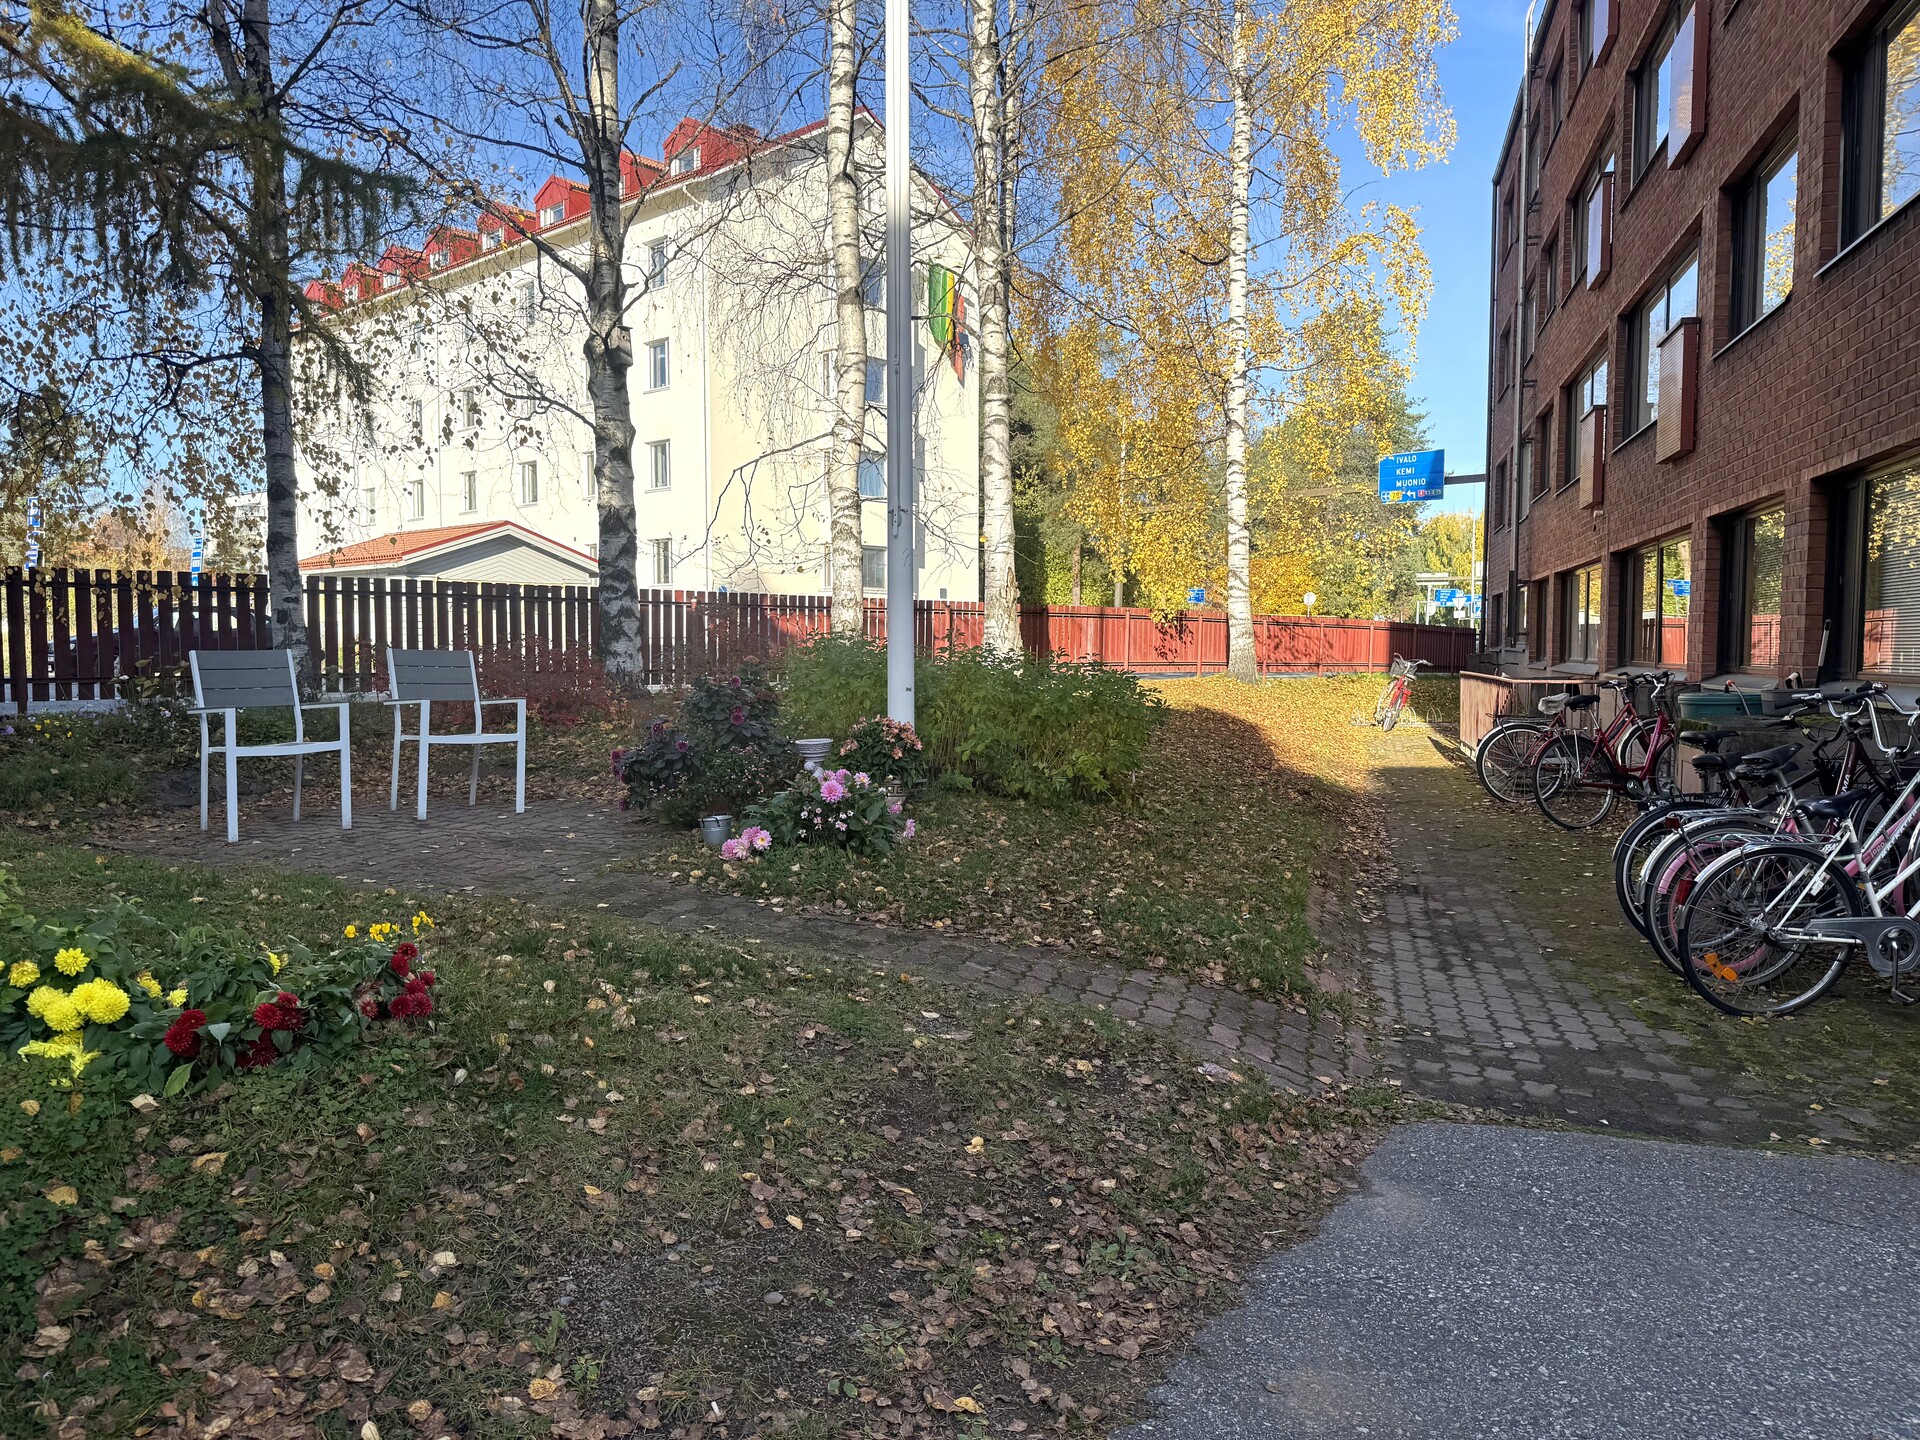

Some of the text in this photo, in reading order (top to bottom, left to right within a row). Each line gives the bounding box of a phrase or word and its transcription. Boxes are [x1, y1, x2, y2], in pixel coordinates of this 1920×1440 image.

[1396, 455, 1417, 464] IVALO
[1396, 467, 1415, 476] KEMI
[1395, 478, 1426, 488] MUONIO
